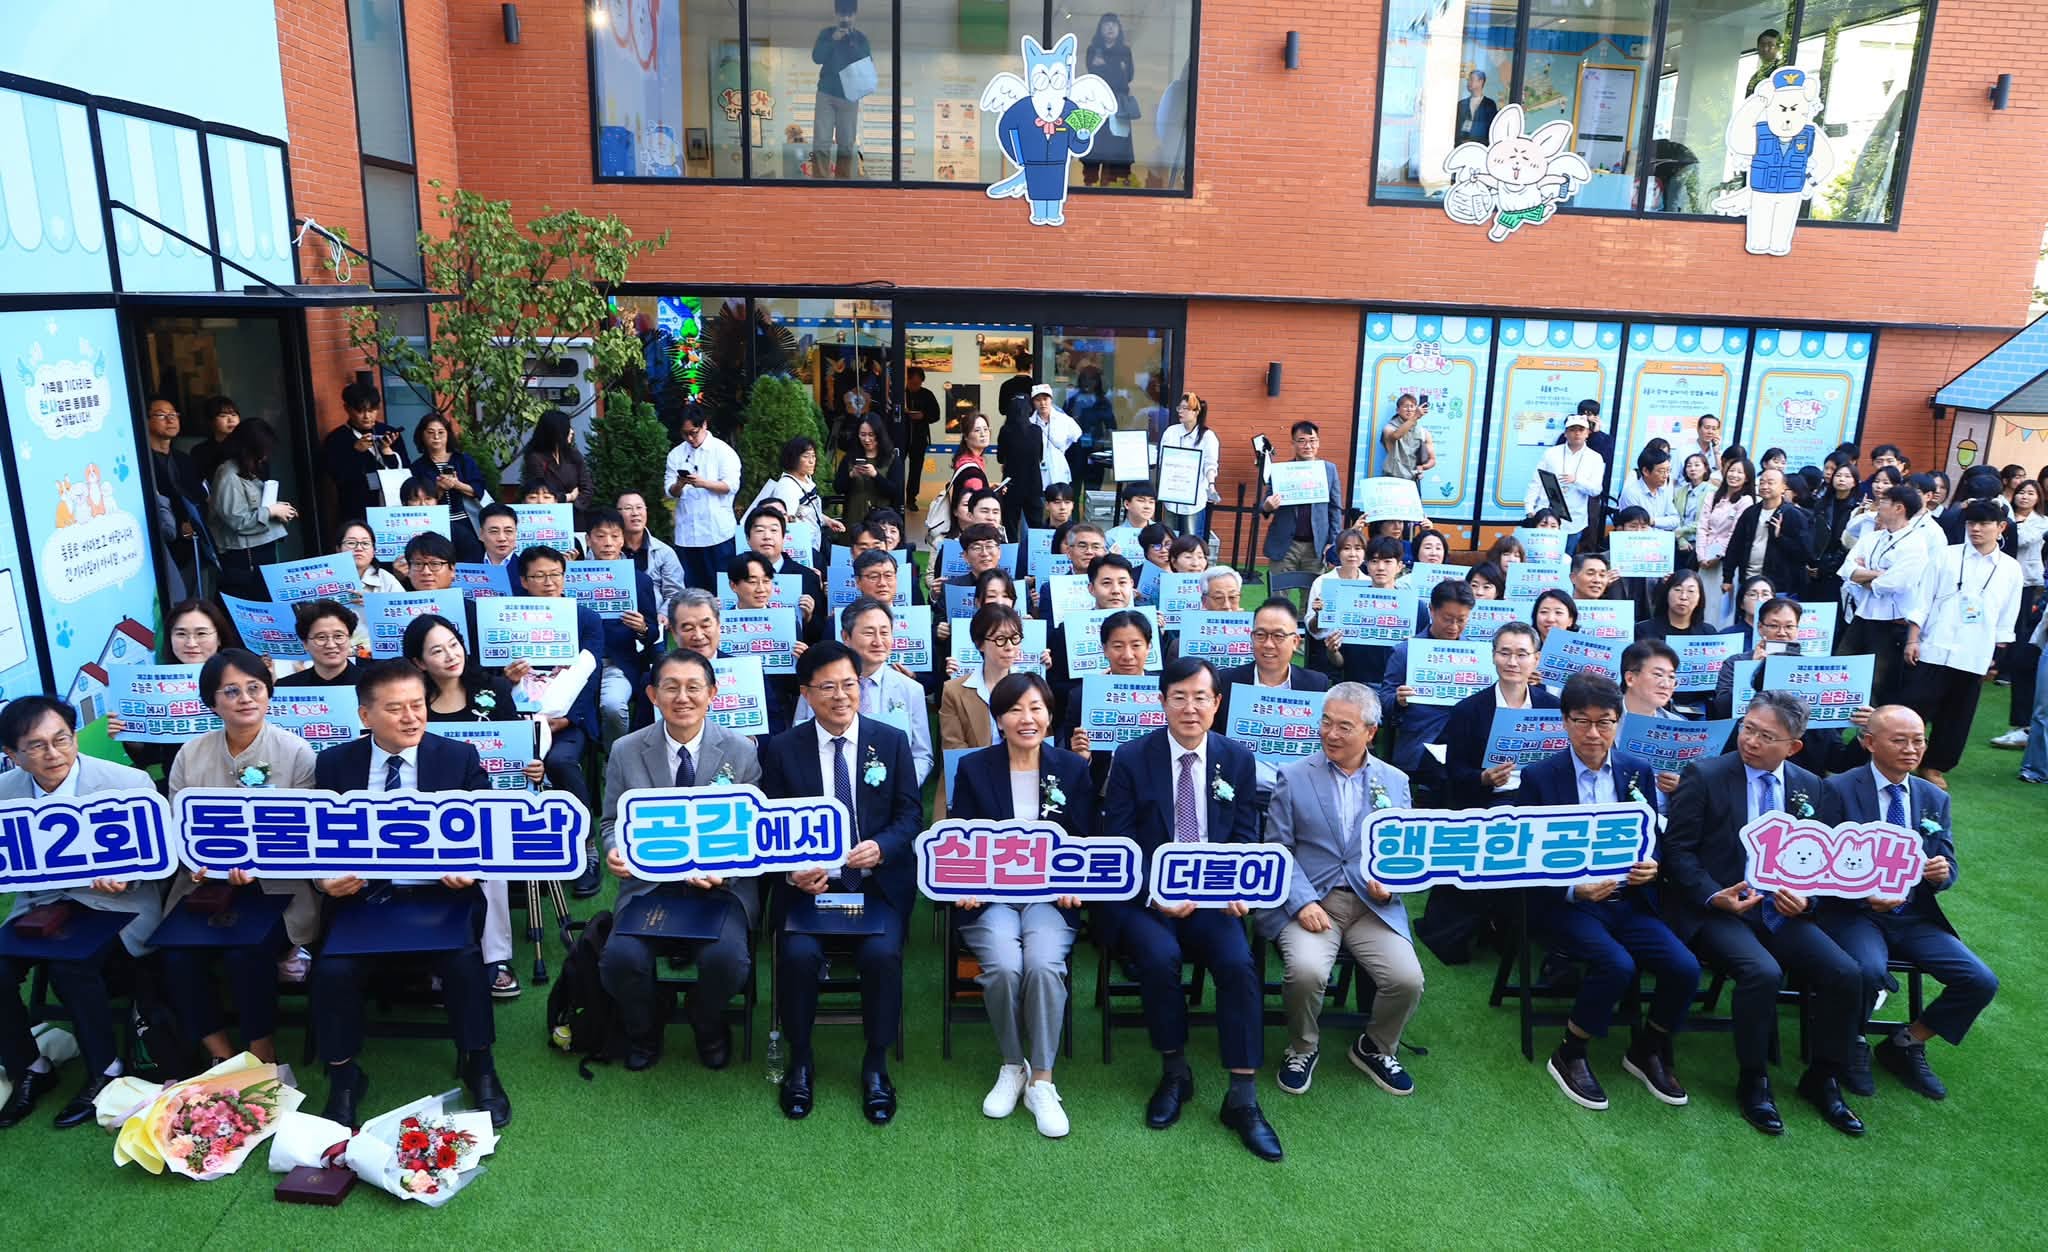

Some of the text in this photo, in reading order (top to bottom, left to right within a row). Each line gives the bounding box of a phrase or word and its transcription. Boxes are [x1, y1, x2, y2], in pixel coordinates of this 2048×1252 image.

[279, 583, 354, 600] 공감에서 실천으로
[594, 589, 629, 598] 실천으로
[611, 602, 632, 611] 공존
[1168, 601, 1198, 609] 공감에서
[383, 608, 402, 617] 오늘은
[499, 613, 517, 622] 오늘은
[1343, 614, 1409, 626] 공감에서 실천으로
[1201, 626, 1218, 634] 오늘은
[1360, 628, 1388, 638] 행복한
[488, 630, 568, 642] 공감에서 실천으로
[751, 640, 788, 651] 실천으로
[1188, 642, 1224, 652] 공감에서
[1563, 645, 1580, 654] 오늘은
[485, 646, 573, 657] 더불어 행복한 공존
[770, 655, 792, 666] 공존
[904, 652, 927, 663] 공존
[1545, 657, 1581, 671] 공감에서
[1416, 671, 1491, 684] 공감에서 실천으로
[1789, 673, 1810, 683] 오늘은
[131, 683, 152, 693] 오늘은
[1436, 686, 1468, 696] 행복한
[712, 696, 756, 708] 실천으로
[1106, 692, 1126, 703] 오늘은
[1821, 691, 1862, 704] 실천으로
[120, 700, 165, 714] 공감에서
[1253, 704, 1273, 715] 오늘은
[736, 712, 762, 726] 공존
[1092, 711, 1135, 724] 공감에서
[149, 719, 190, 733] 행복한
[304, 724, 349, 736] 실천으로
[1237, 721, 1279, 735] 공감에서
[1515, 723, 1536, 732] 오늘은
[1087, 731, 1112, 740] 더불어
[1648, 730, 1669, 740] 오늘은
[1261, 741, 1299, 753] 행복한
[1498, 738, 1538, 750] 공감에서
[1630, 742, 1673, 758] 공감에서
[1490, 753, 1514, 763] 더불어
[498, 776, 525, 788] 공존
[185, 804, 566, 862] 동물보호의 날
[633, 801, 829, 862] 공감에서
[1376, 816, 1639, 876] 행복한 공존
[933, 835, 1121, 887] 실천으로
[1165, 857, 1274, 892] 더불어
